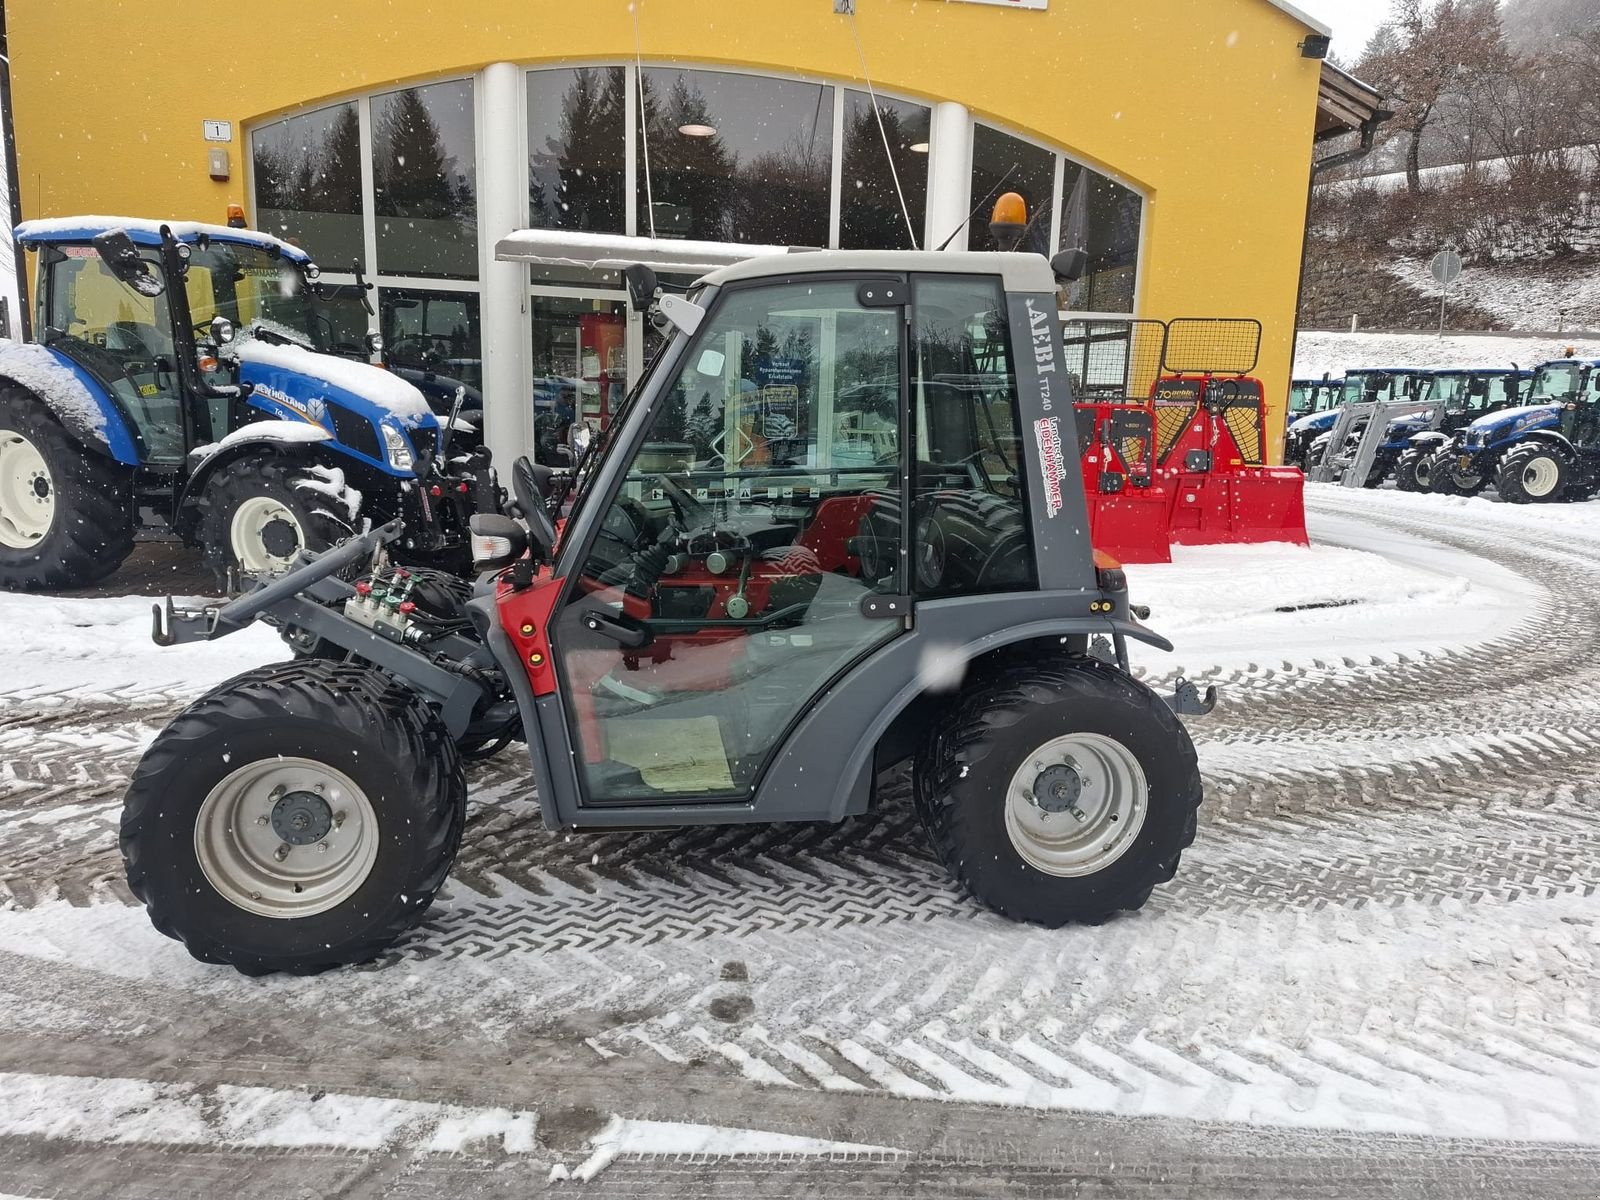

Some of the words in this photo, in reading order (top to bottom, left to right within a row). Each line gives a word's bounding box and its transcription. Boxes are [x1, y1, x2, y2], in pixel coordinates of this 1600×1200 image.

[215, 125, 220, 136] 1
[1028, 307, 1056, 375] AEBI
[253, 384, 272, 396] NEW
[271, 389, 307, 413] HOLLAND
[1040, 377, 1052, 411] TT240
[1040, 418, 1063, 510] EIDENHAMMER
[1049, 417, 1067, 480] Landtechnik
